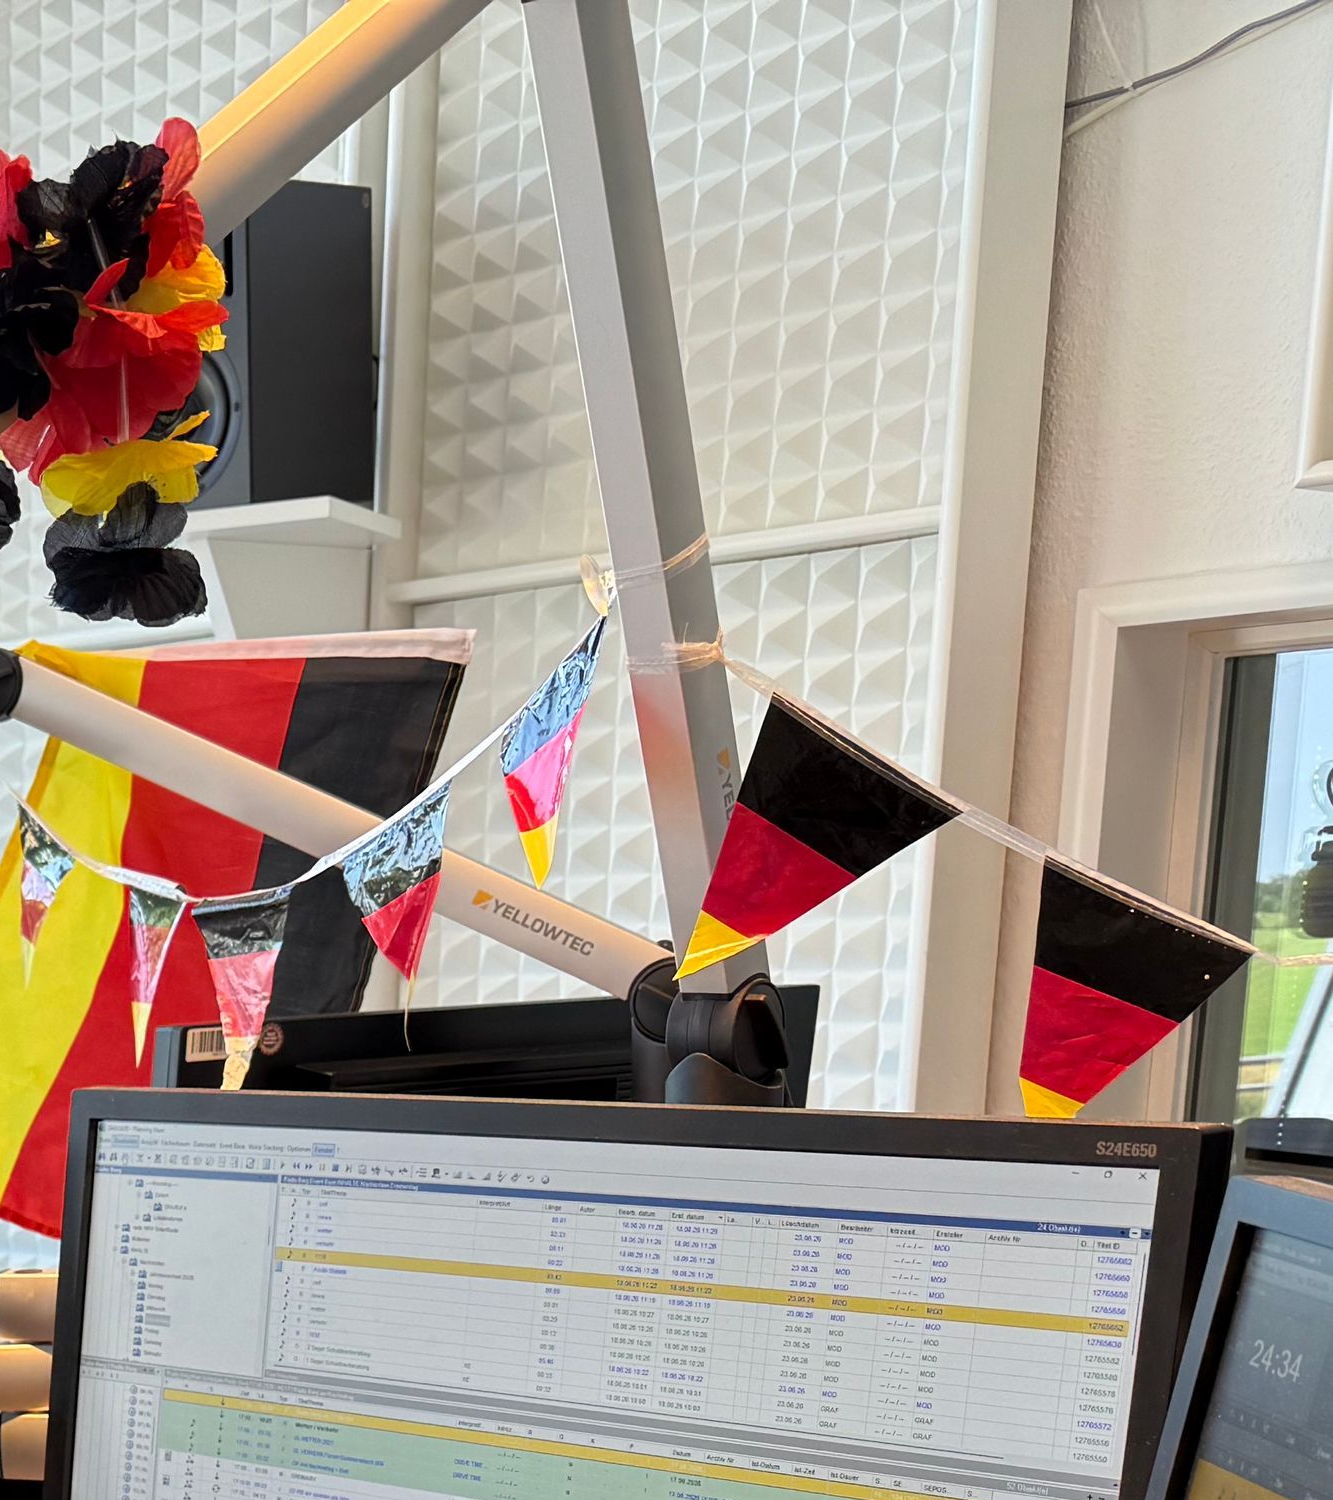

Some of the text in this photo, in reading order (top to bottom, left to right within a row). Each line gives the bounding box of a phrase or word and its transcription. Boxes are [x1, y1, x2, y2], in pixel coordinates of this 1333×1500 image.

[494, 899, 594, 956] YELLOWTEC
[1096, 1140, 1158, 1158] S24E650
[1249, 1339, 1303, 1383] 24:34
